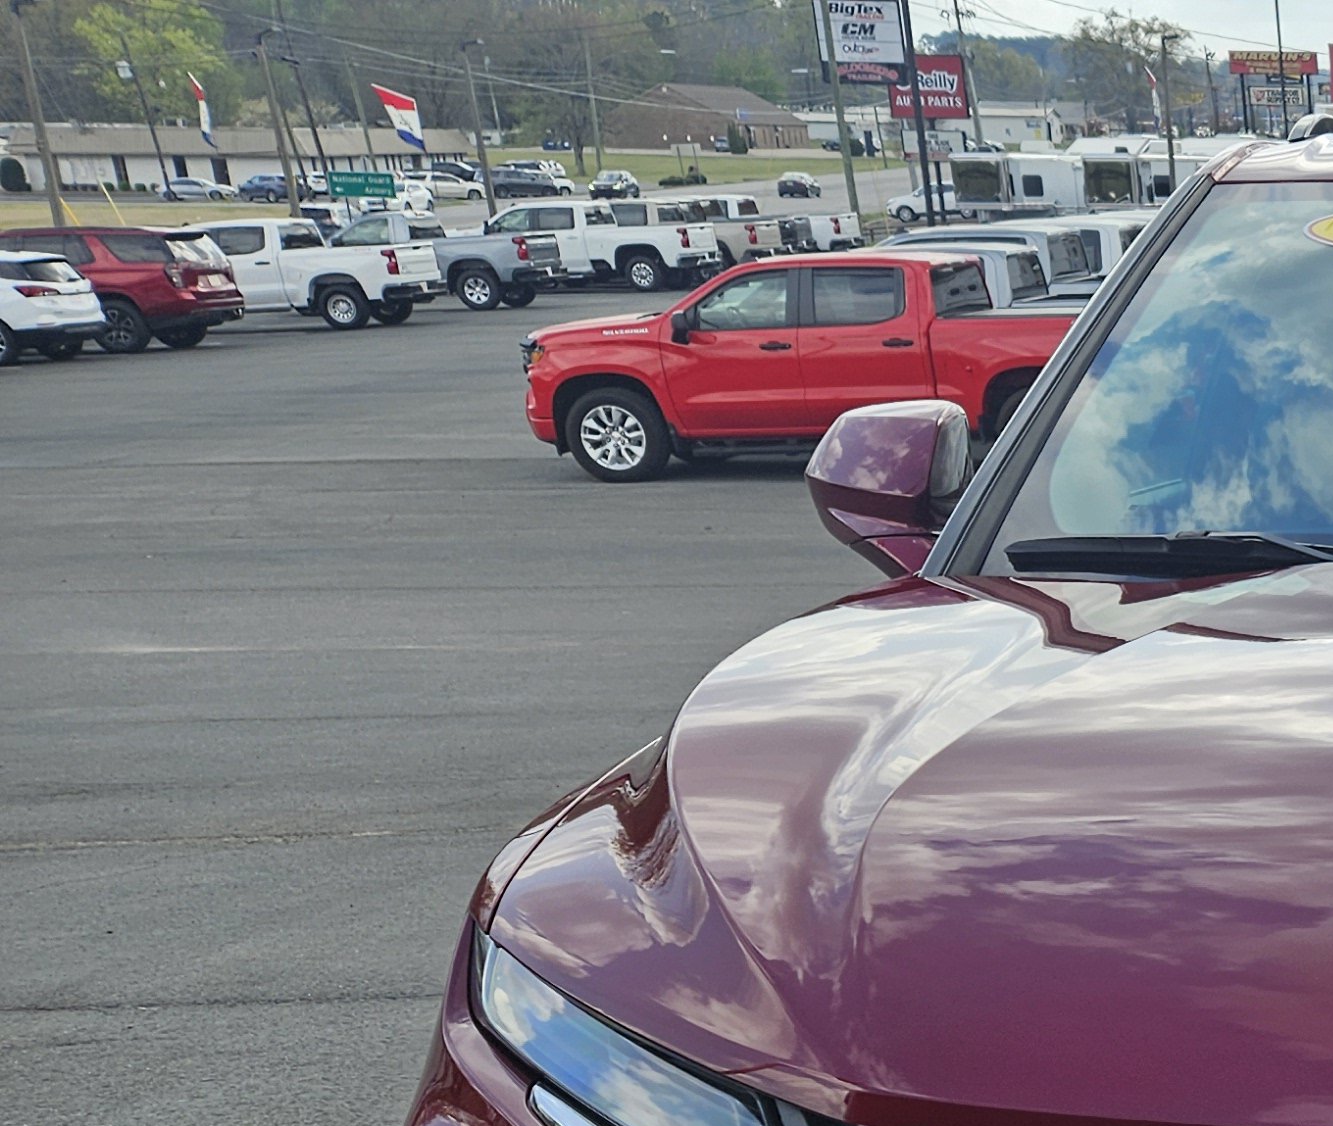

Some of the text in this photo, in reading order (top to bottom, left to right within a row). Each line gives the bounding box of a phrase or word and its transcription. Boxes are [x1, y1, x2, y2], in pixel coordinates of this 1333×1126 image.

[896, 95, 962, 108] AU PARTS
[332, 175, 365, 183] National
